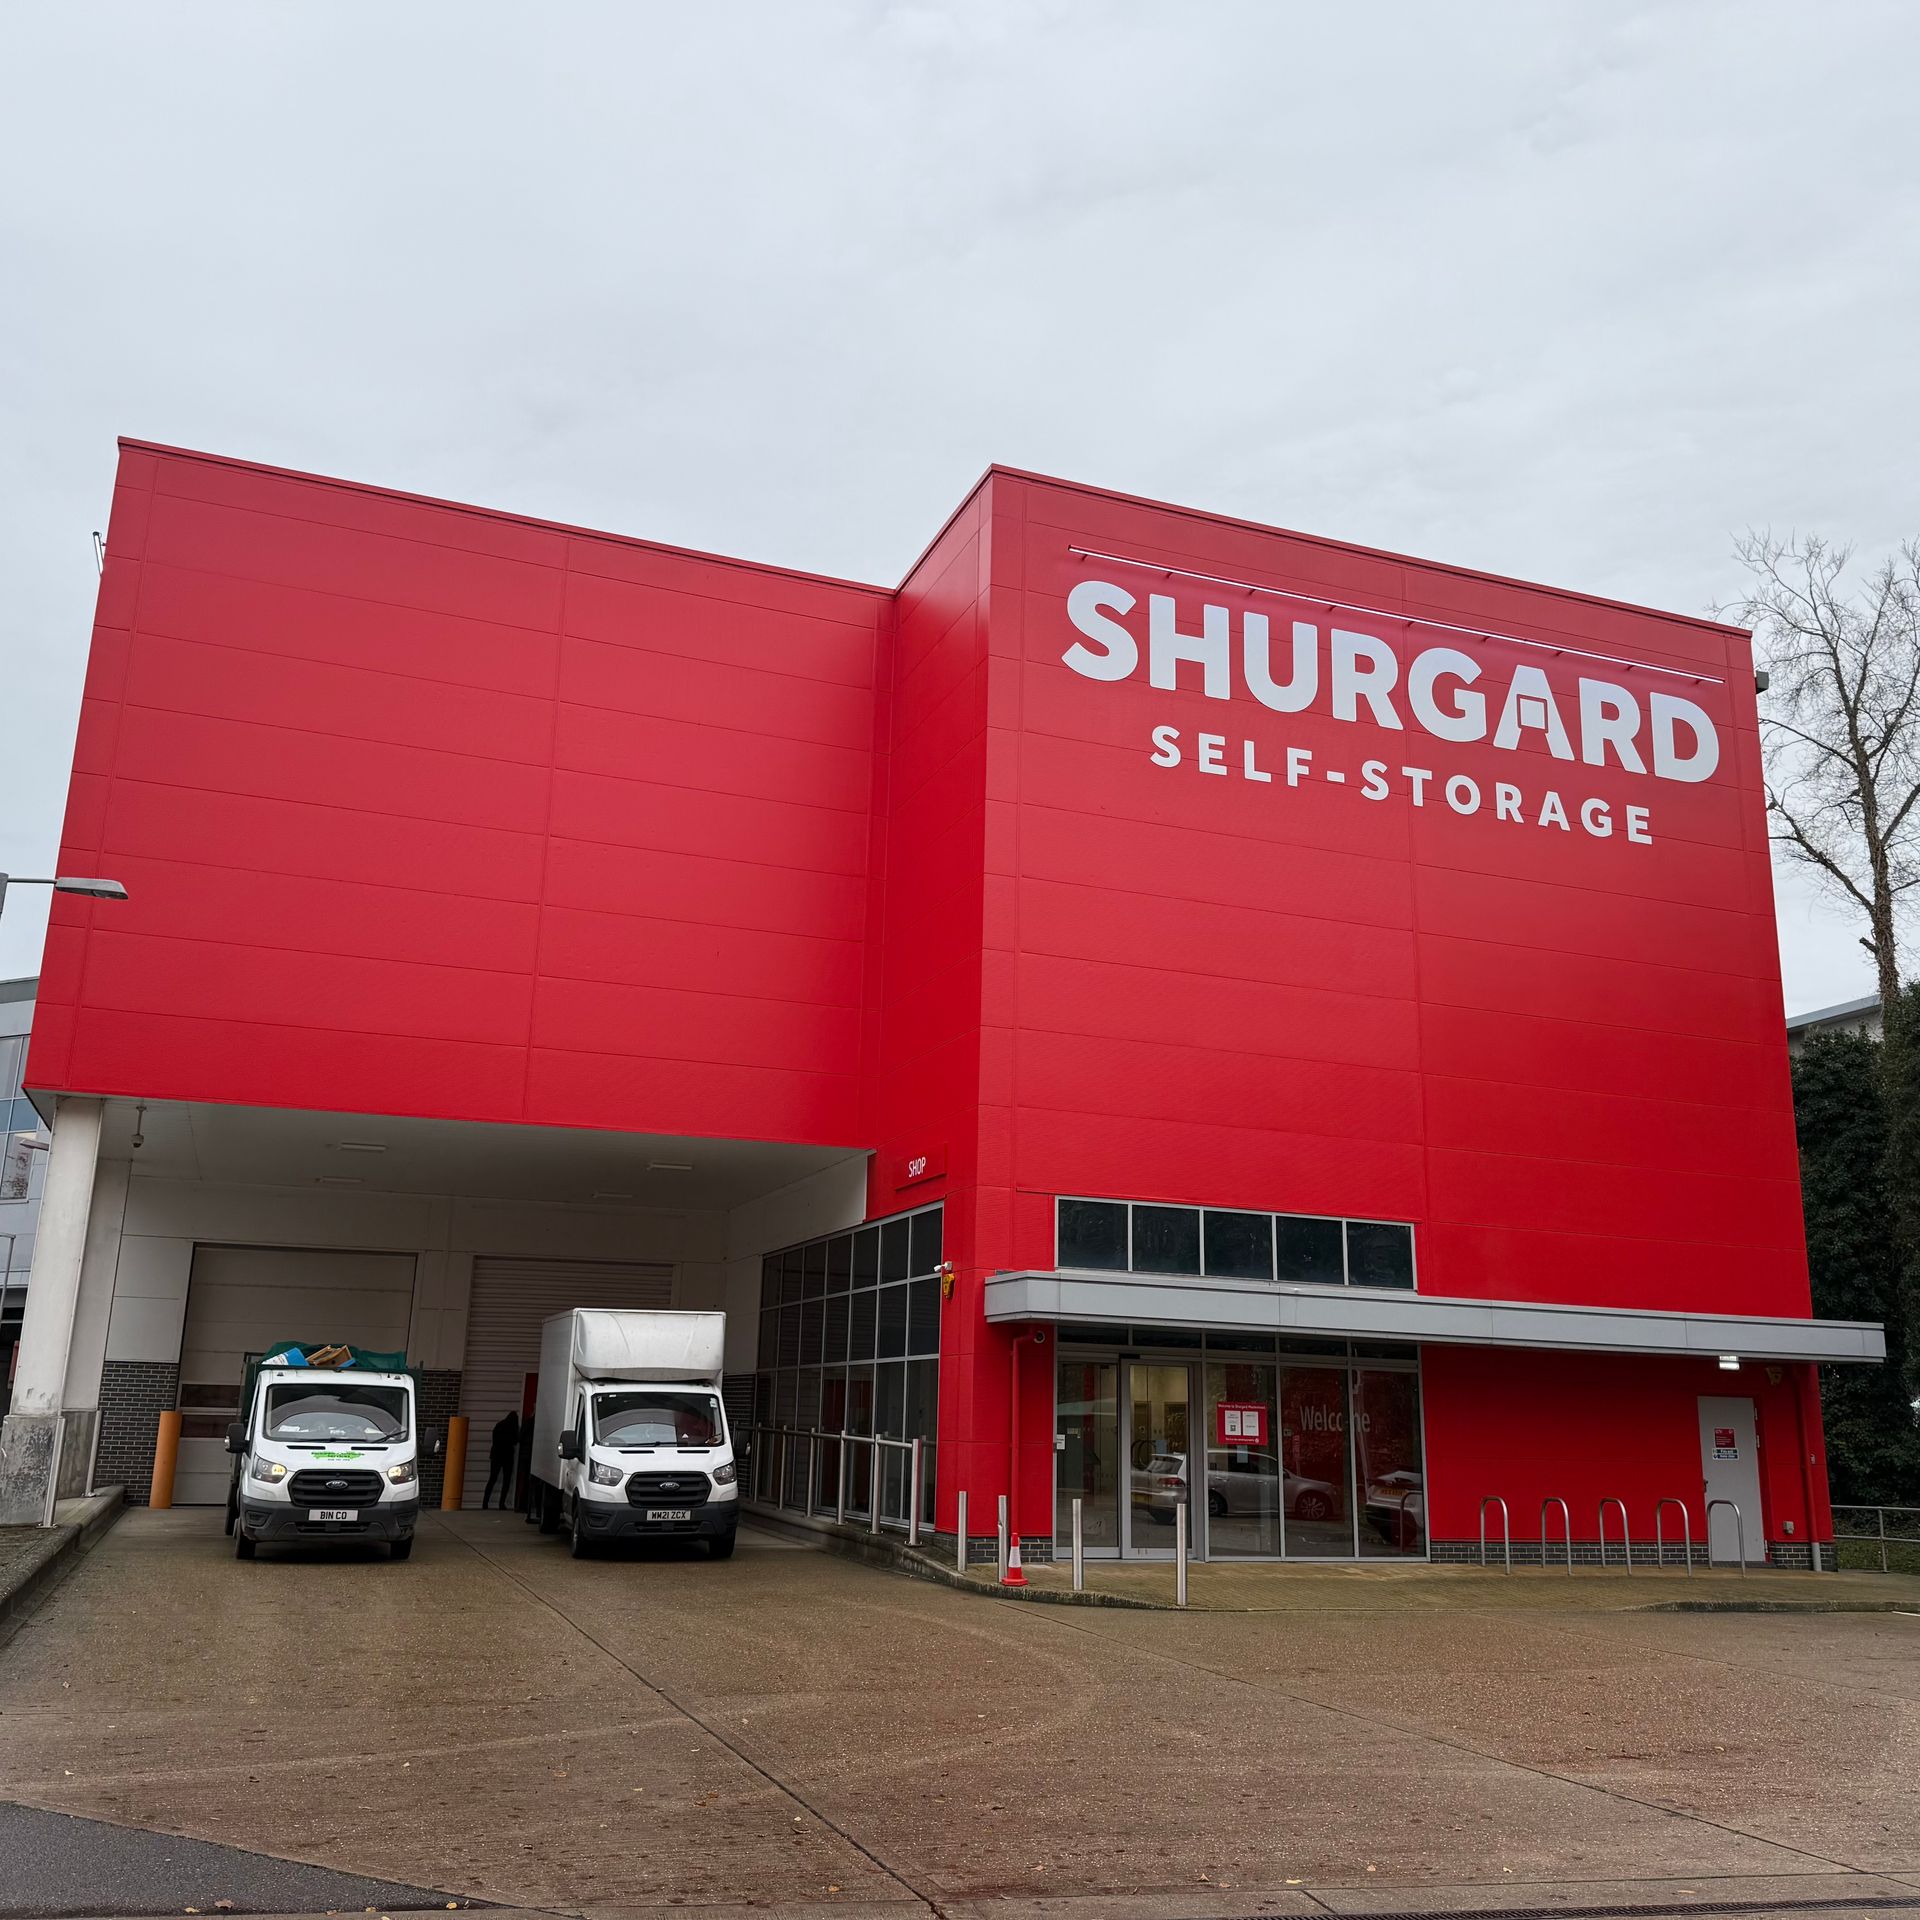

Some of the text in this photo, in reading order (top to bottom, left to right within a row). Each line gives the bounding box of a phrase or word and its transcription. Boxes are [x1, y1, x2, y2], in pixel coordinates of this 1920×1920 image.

[1062, 581, 1720, 783] SHURGARD
[1150, 726, 1653, 844] SELF-STORAGE
[908, 1156, 927, 1178] SHOP
